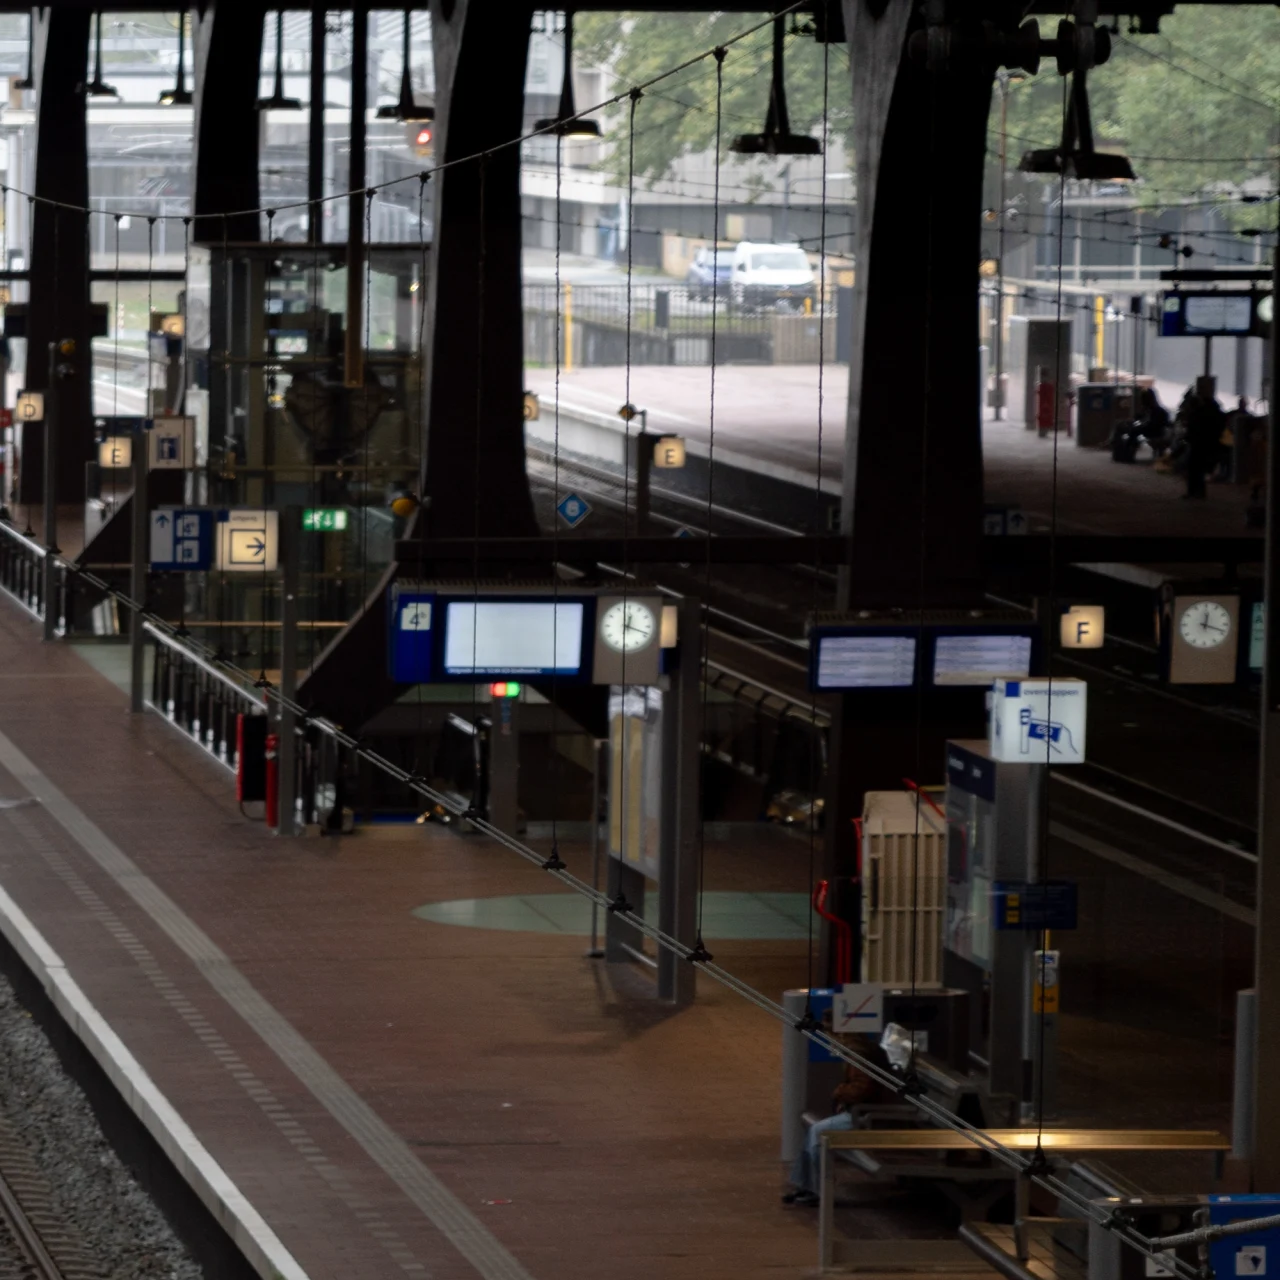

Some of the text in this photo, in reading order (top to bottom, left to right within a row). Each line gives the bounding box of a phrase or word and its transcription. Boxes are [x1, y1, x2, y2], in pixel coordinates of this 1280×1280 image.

[24, 404, 36, 418] D
[112, 448, 121, 465] E
[665, 448, 675, 465] E
[1076, 621, 1090, 644] F
[1024, 689, 1079, 698] oversappen
